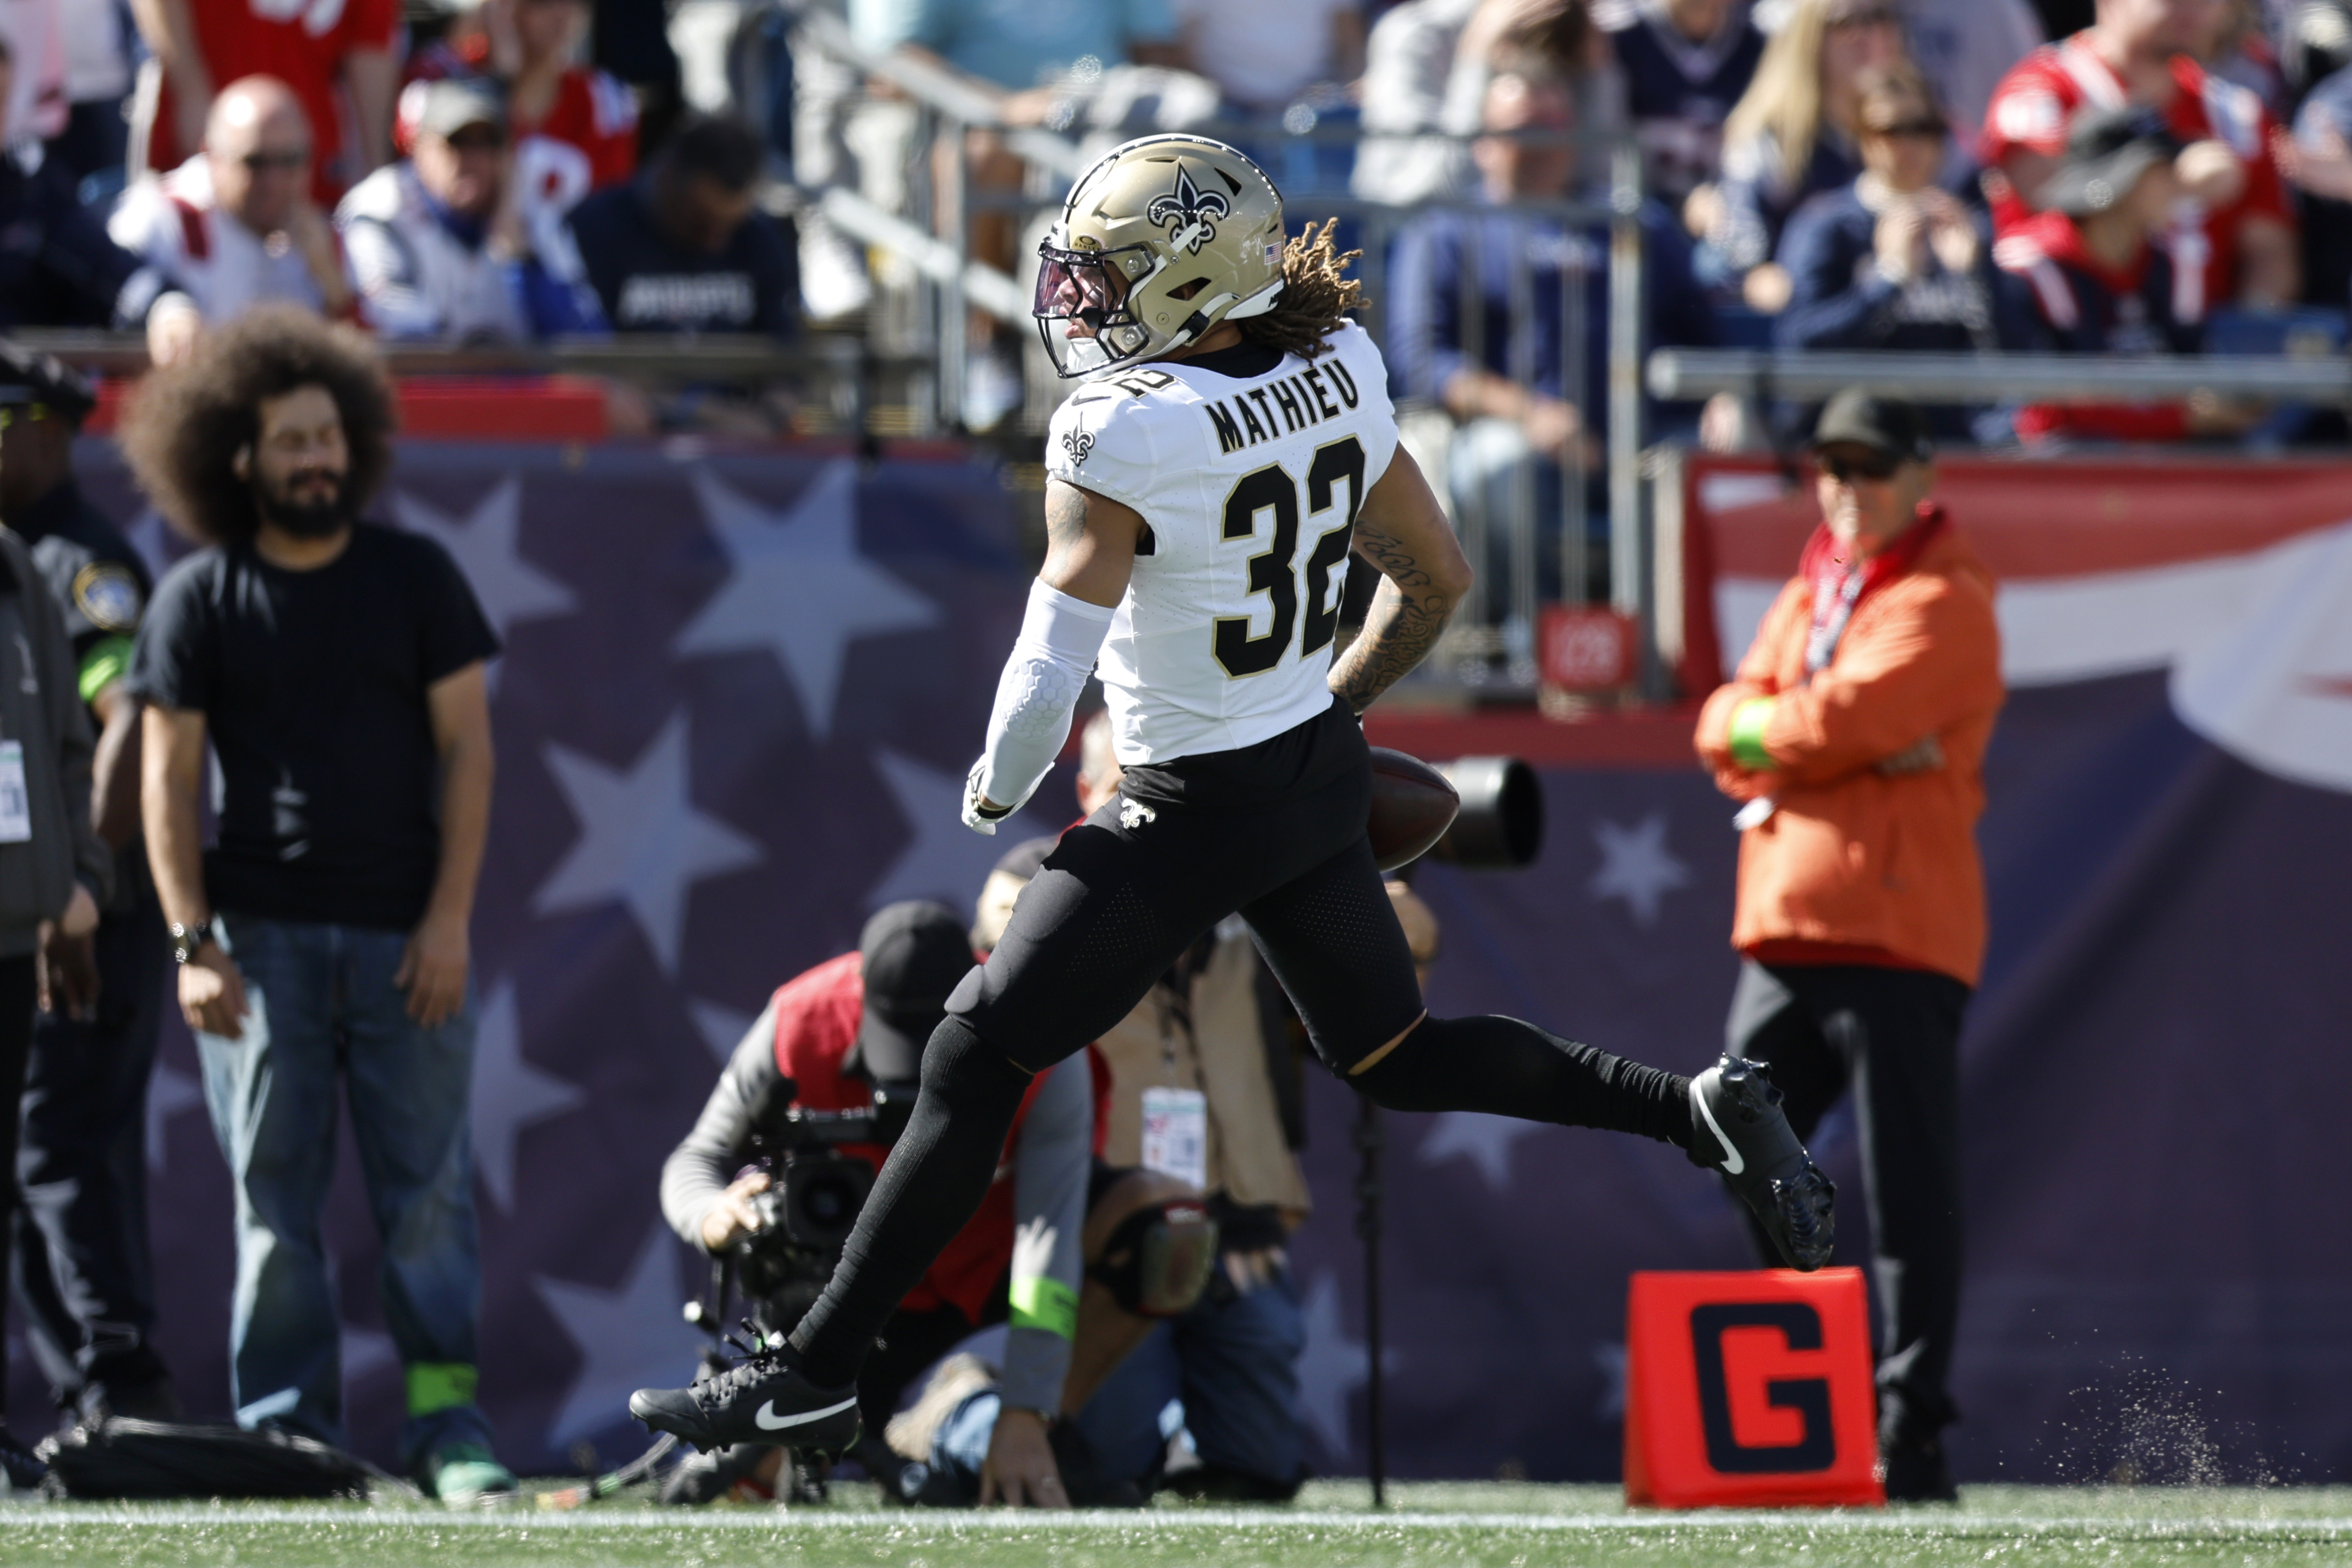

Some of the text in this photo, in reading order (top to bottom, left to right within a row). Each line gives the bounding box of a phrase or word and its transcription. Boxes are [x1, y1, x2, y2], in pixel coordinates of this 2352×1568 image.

[1202, 358, 1358, 456] MATHIEU
[1212, 433, 1367, 681] 32
[1692, 1303, 1836, 1473] G
